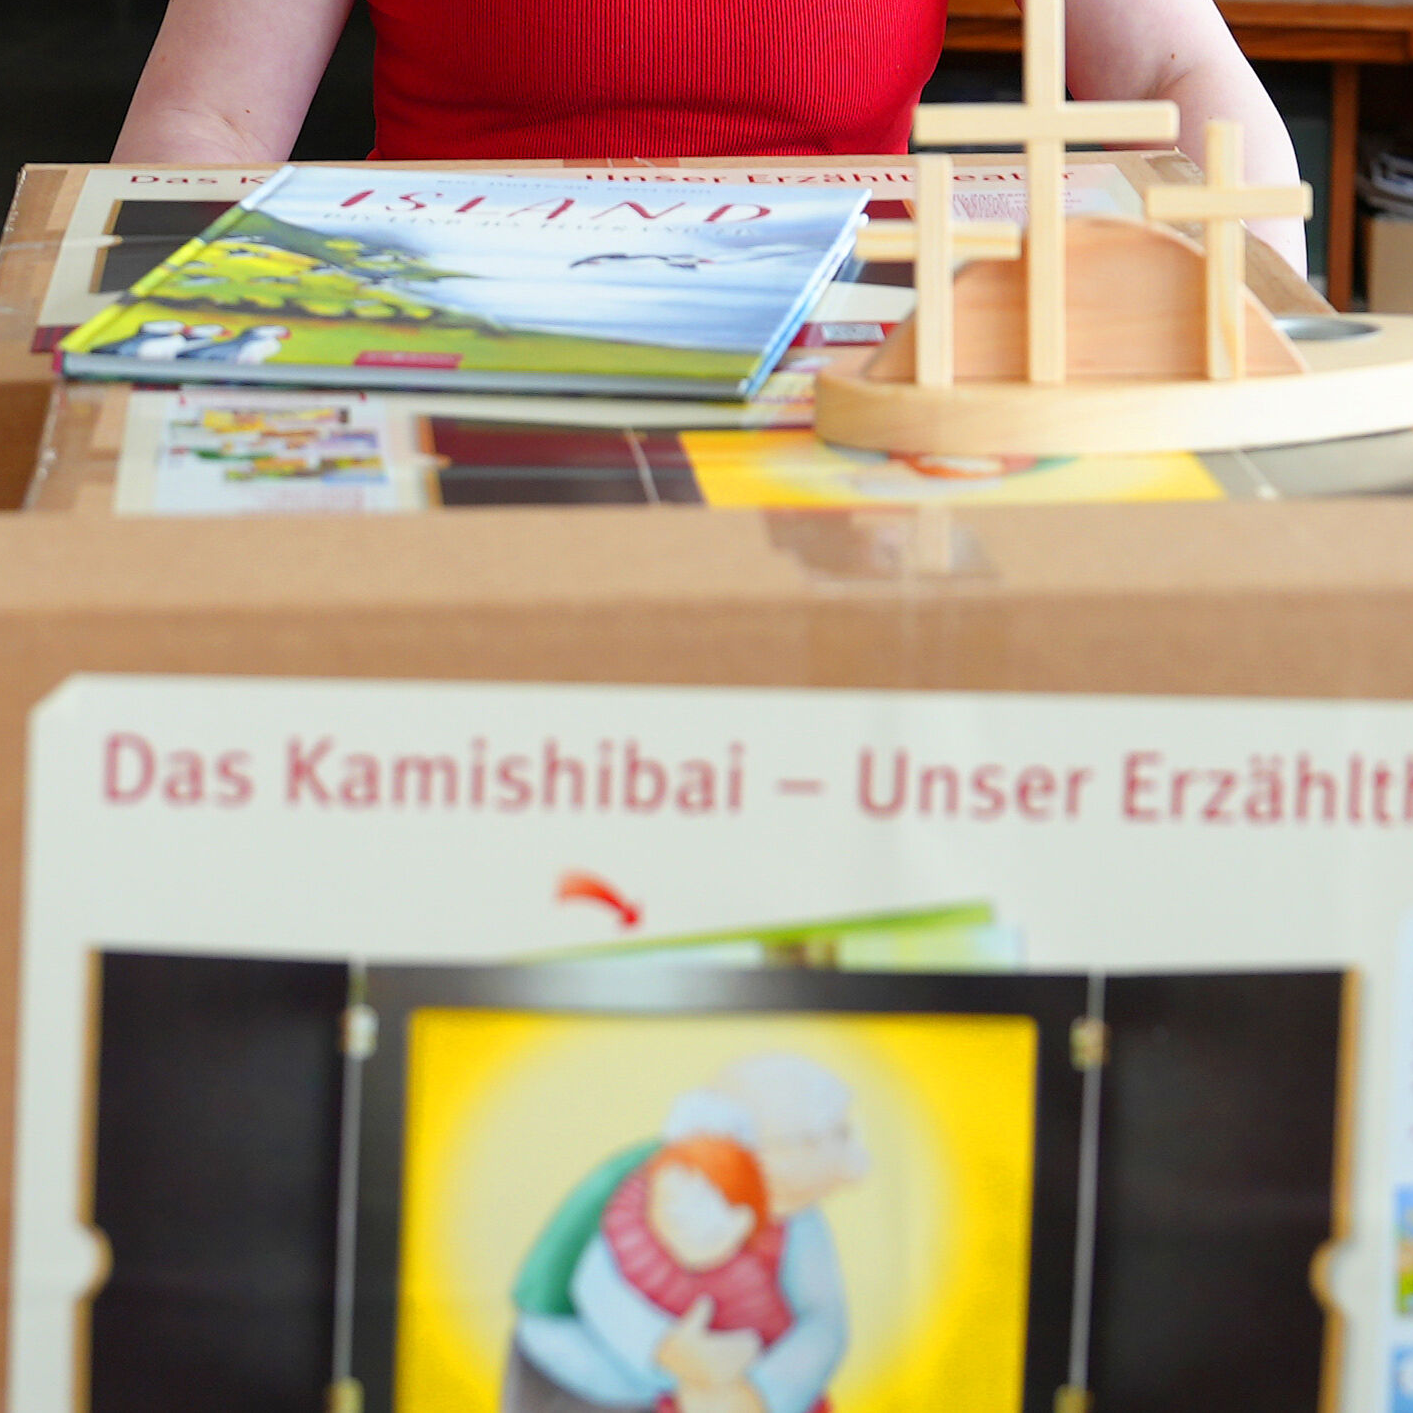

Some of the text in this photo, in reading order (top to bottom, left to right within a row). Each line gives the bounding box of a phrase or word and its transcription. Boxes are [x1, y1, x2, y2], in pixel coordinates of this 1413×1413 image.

[129, 174, 218, 185] Das
[746, 173, 1074, 183] Erzählteatr
[339, 189, 772, 223] ISLAND
[101, 732, 254, 807] Das
[284, 736, 746, 815] Kamishibai
[854, 747, 1092, 820] Unser
